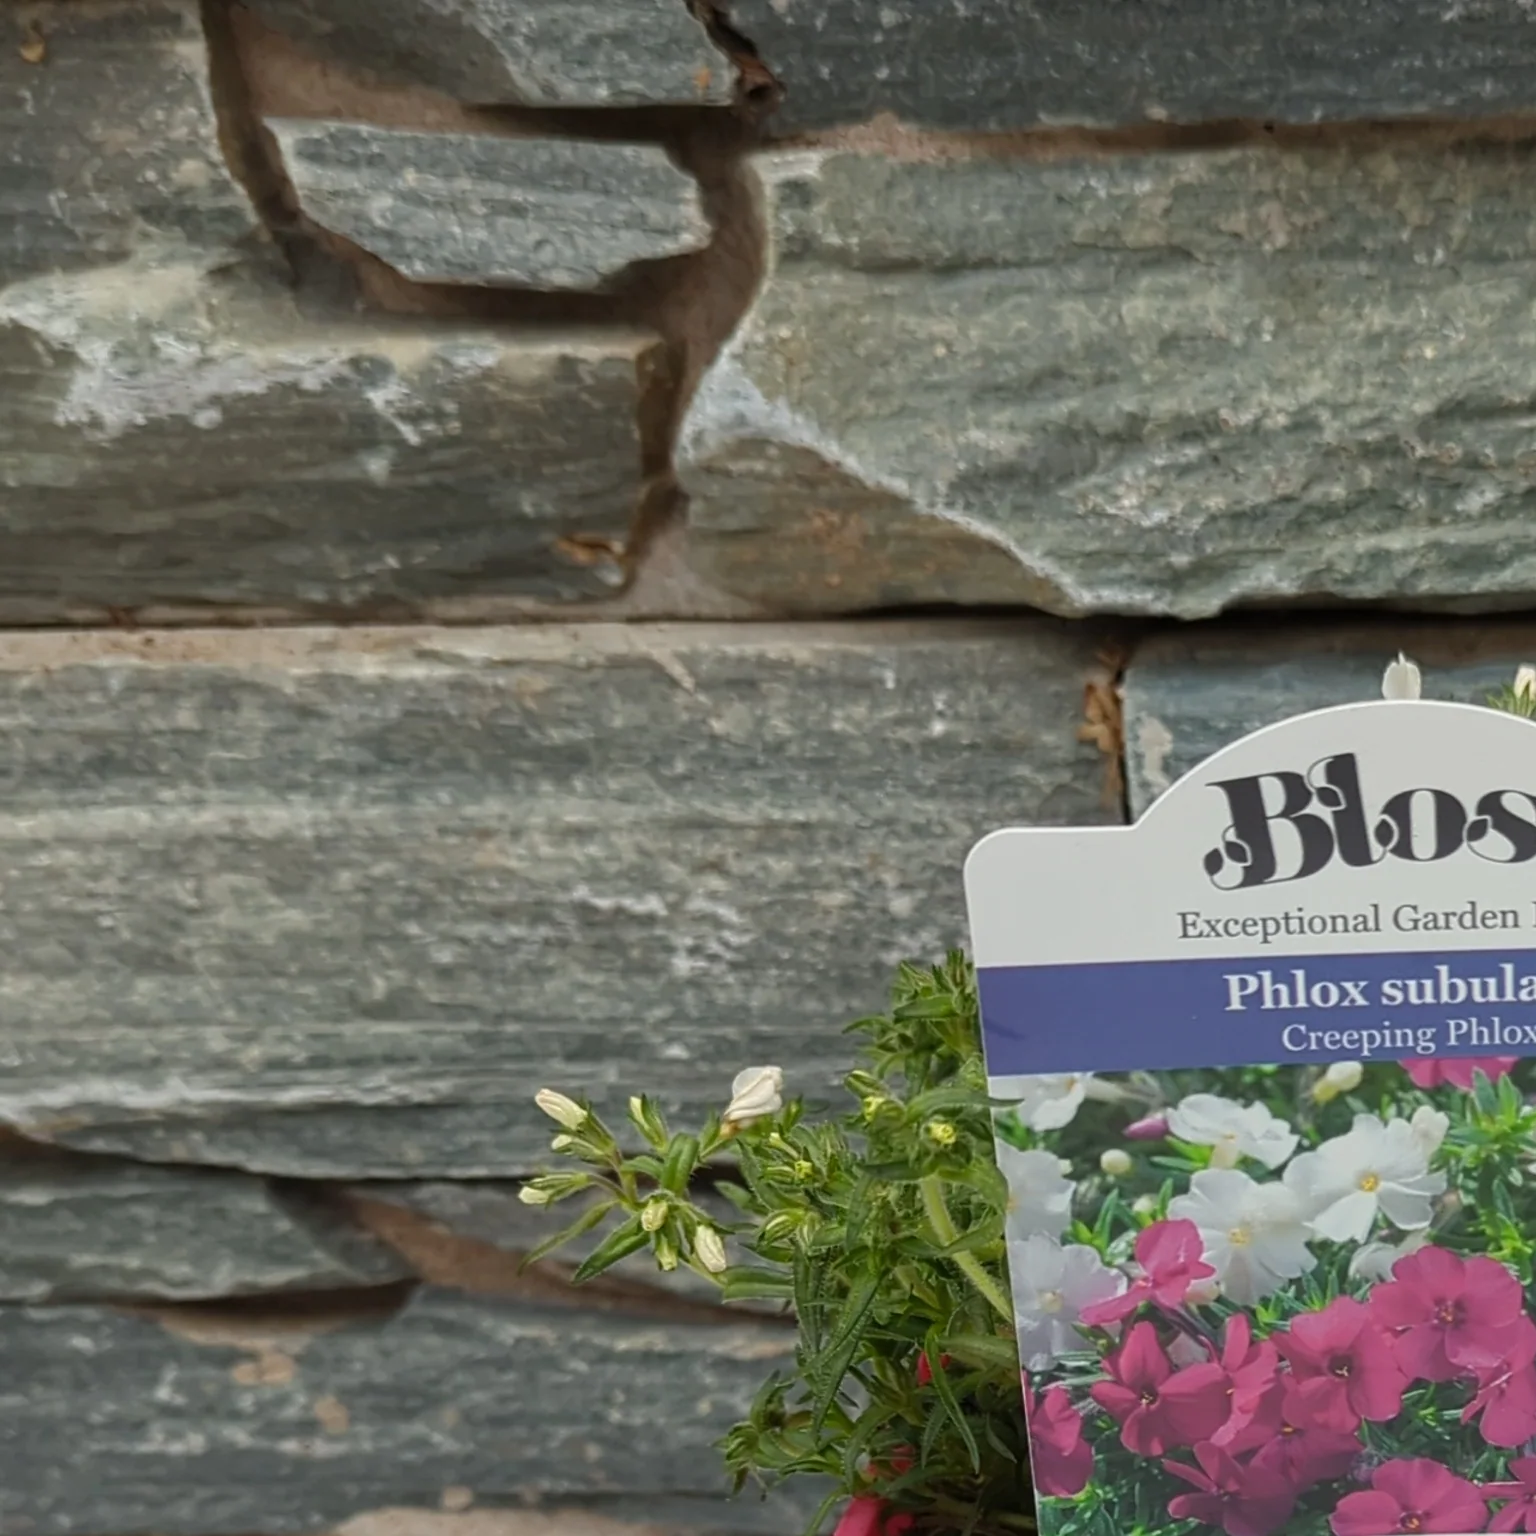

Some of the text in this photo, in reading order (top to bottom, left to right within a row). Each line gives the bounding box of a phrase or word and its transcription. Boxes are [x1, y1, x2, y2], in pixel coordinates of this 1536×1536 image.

[1177, 904, 1382, 944] Exceptional
[1392, 901, 1520, 933] Garden
[1223, 968, 1370, 1011] Phlox
[1281, 1020, 1437, 1056] Creeping
